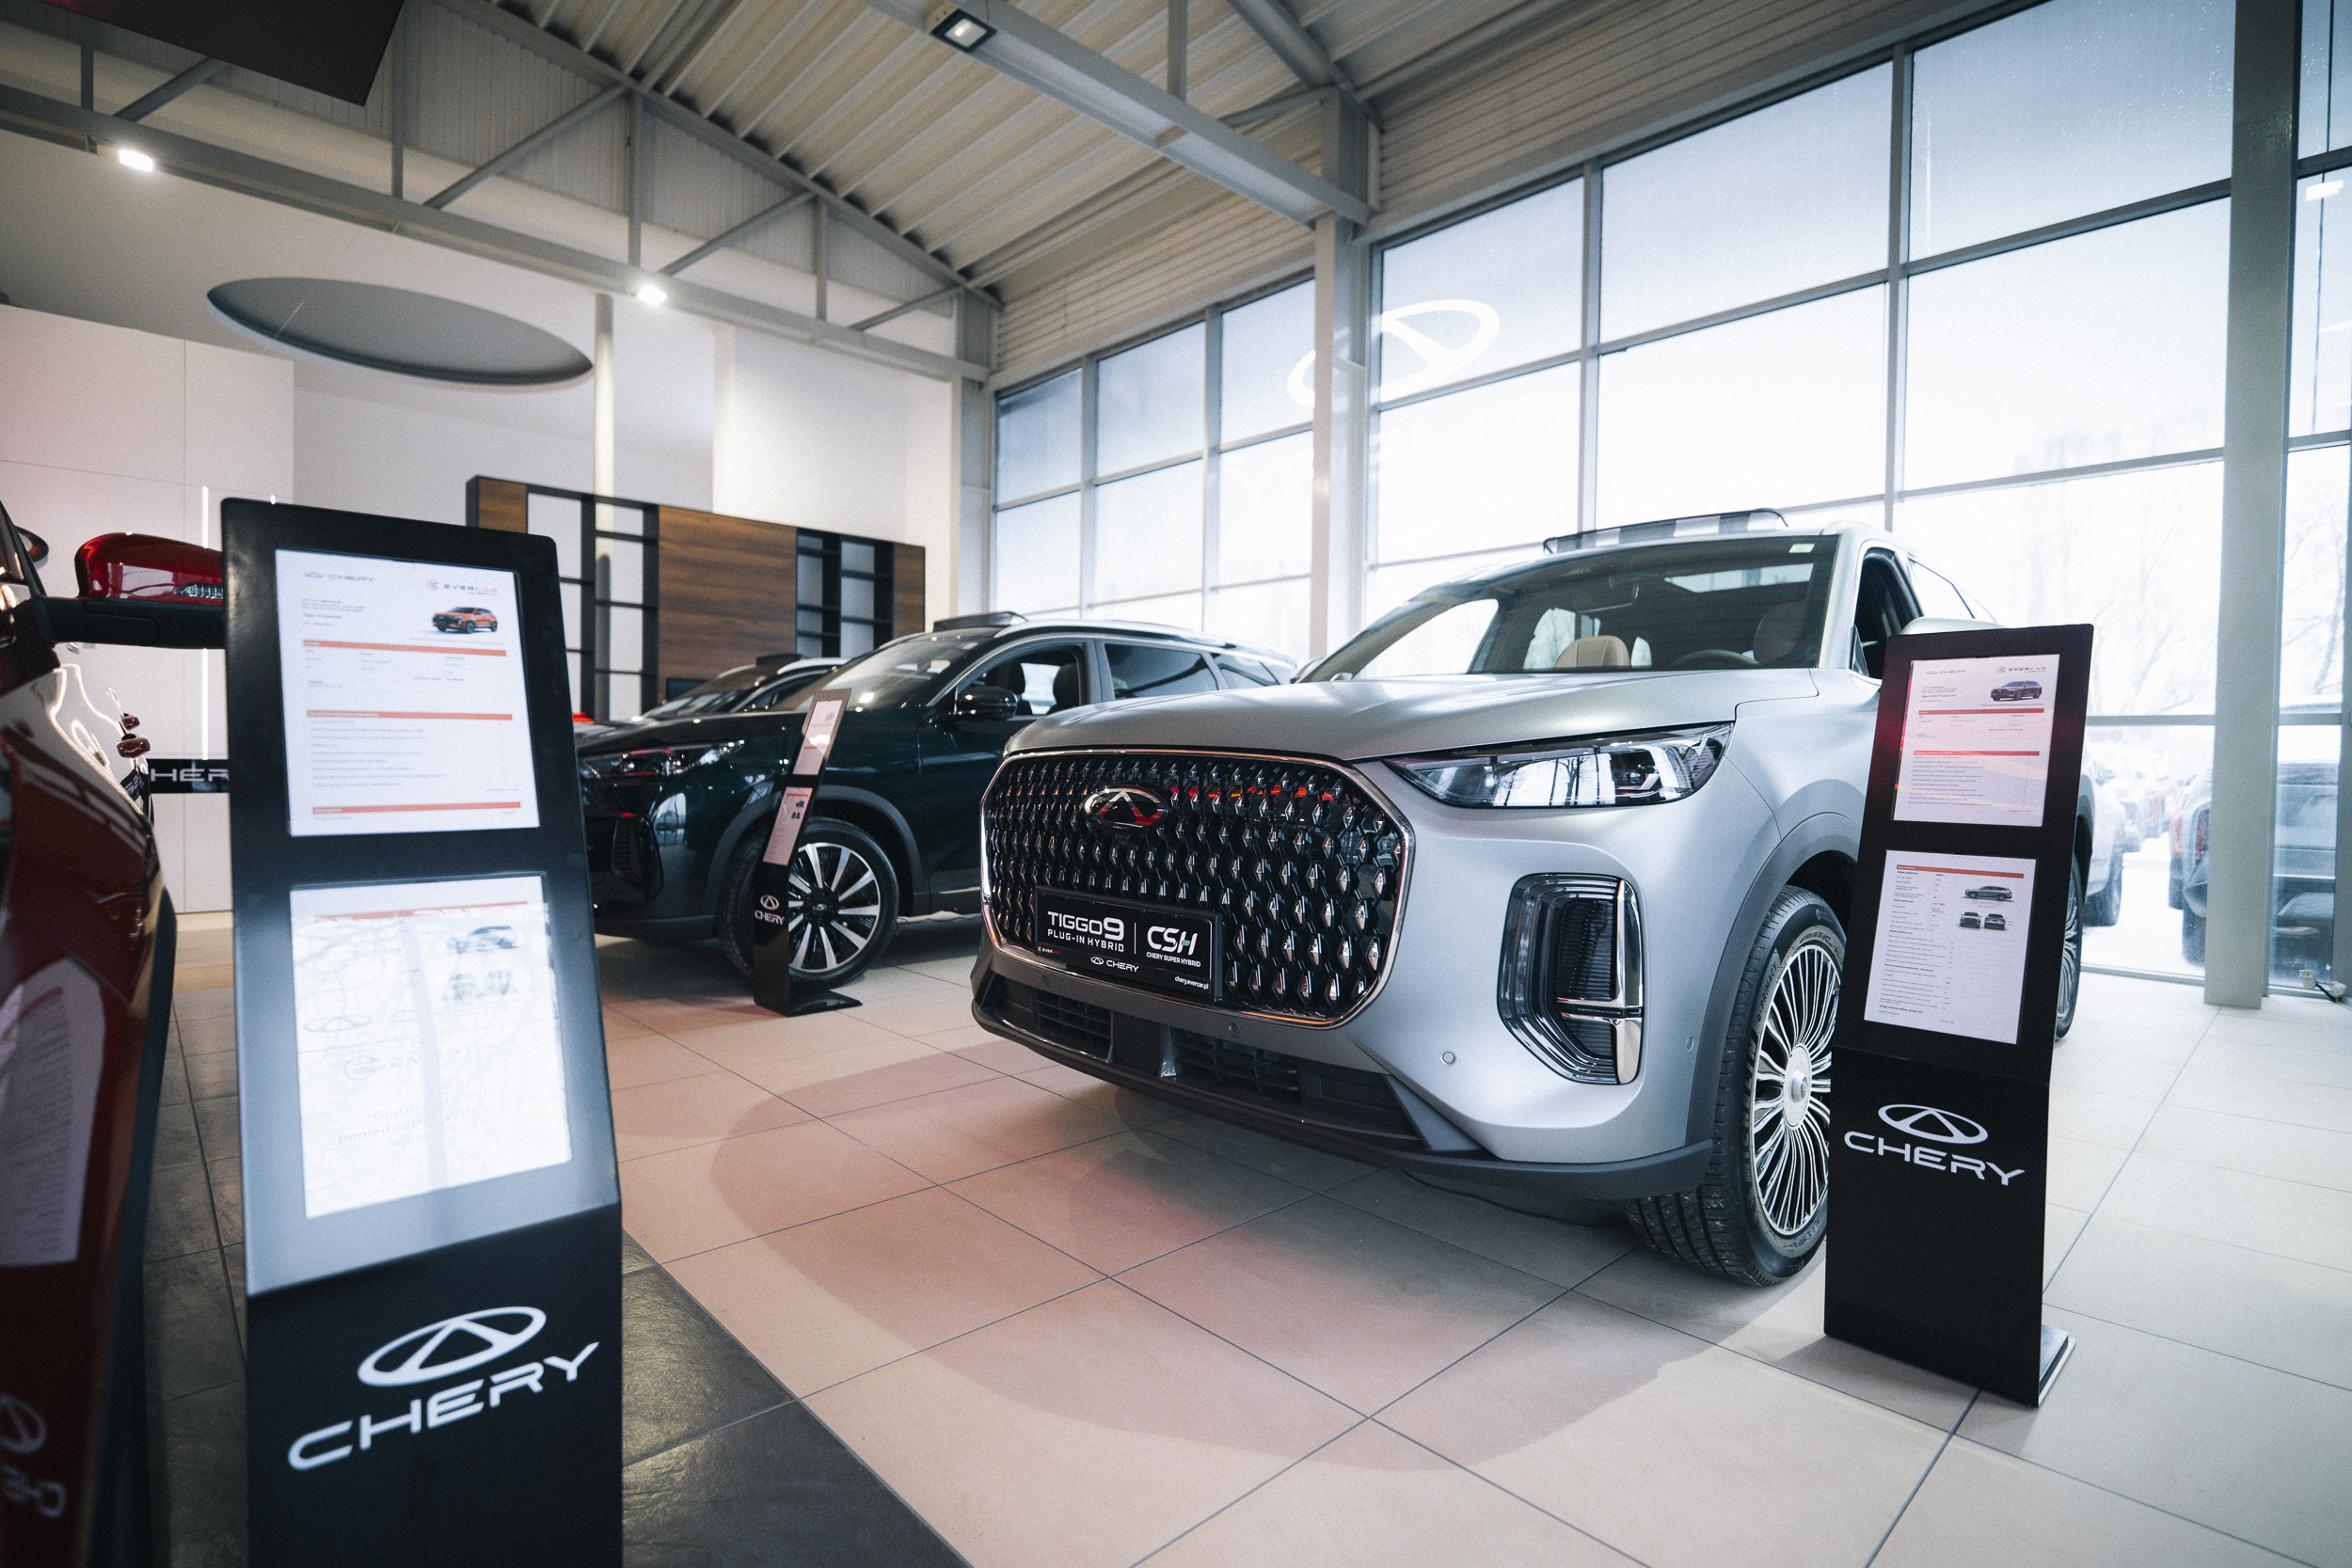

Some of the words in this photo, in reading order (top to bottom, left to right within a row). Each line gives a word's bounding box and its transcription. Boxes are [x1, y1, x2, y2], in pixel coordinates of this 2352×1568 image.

[755, 911, 785, 926] CHERY
[1047, 928, 1085, 945] PLUG-IN
[1087, 937, 1125, 953] HYBRID
[1147, 926, 1199, 956] CSH
[1106, 959, 1139, 973] CHERY
[1146, 951, 1164, 960] CHERY
[1163, 955, 1181, 964] SUPER
[1181, 958, 1201, 968] HYBRID
[1174, 975, 1209, 990] chery.evercar.pl
[1844, 1131, 2025, 1186] CHERY
[288, 1341, 600, 1471] CHERY
